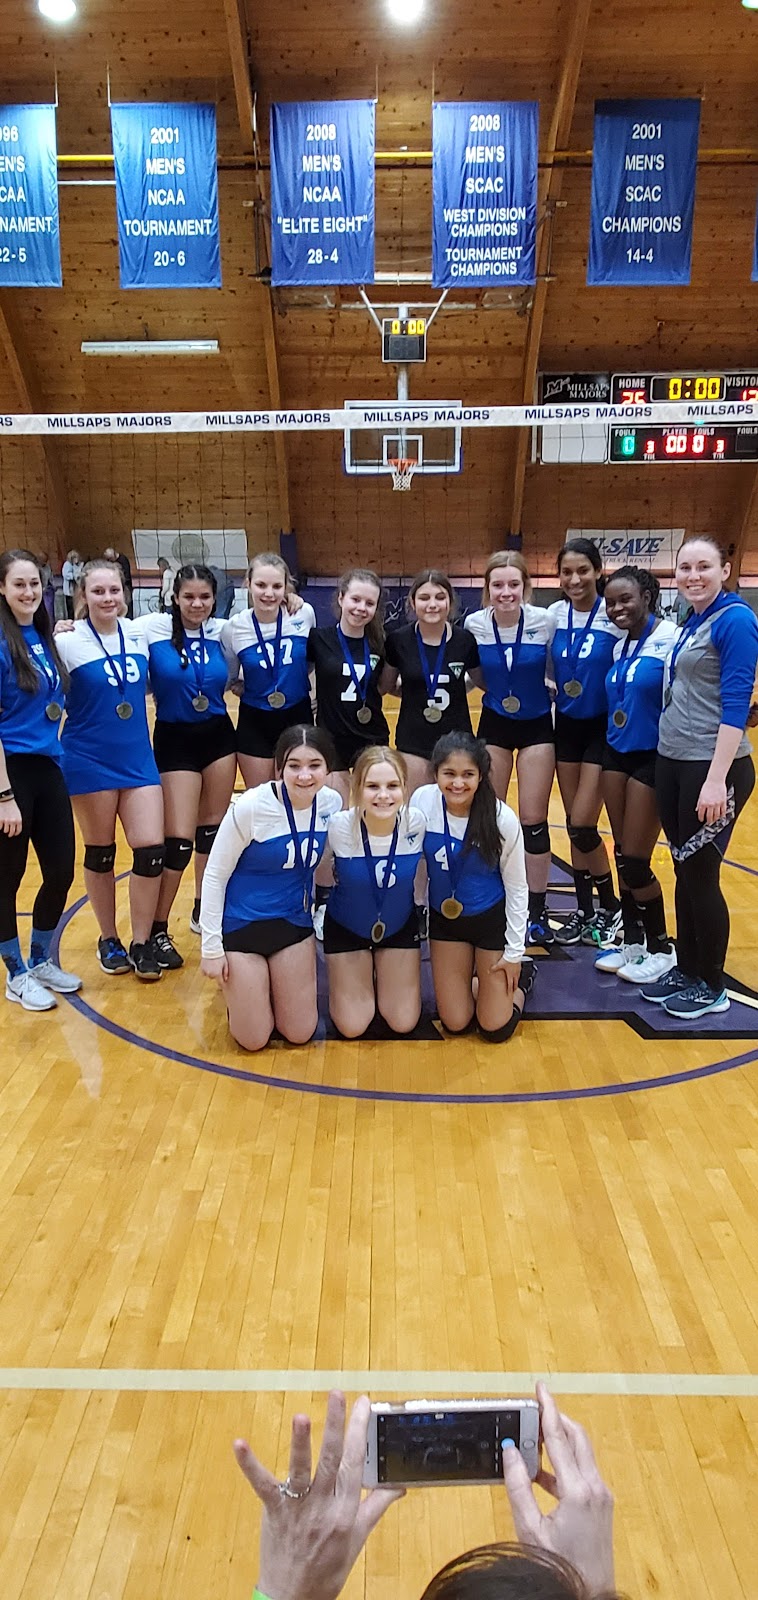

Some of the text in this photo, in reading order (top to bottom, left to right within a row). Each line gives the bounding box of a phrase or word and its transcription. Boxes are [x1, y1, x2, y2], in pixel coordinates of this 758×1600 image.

[470, 114, 501, 132] 2008
[632, 123, 662, 140] 2001
[0, 125, 19, 142] 96
[150, 127, 180, 144] 2001
[306, 124, 337, 141] 2008
[302, 154, 342, 172] MEN'S
[465, 146, 505, 164] MEN'S
[625, 154, 665, 171] MEN'S
[146, 157, 186, 175] MEN'S
[465, 177, 504, 194] SCAC
[625, 185, 662, 202] SCAC
[147, 189, 186, 206] NCAA
[303, 186, 342, 203] NCAA
[443, 206, 527, 223] WEST DIVISION
[123, 218, 213, 237] TOURNAMENT
[277, 215, 369, 234] "ELITE EIGHT"
[451, 221, 519, 238] CHAMPIONS
[602, 216, 682, 234] CHAMPIONS
[445, 246, 523, 262] TOURNAMENT
[626, 247, 654, 264] 14-4
[450, 261, 518, 277] CHAMPIONS
[391, 319, 425, 335] 0:00
[567, 383, 610, 391] MILLSAPS
[619, 378, 646, 389] HOME
[668, 377, 720, 400] 0:00
[569, 390, 607, 399] MAJORS
[205, 412, 332, 425] MILLSAPS MAJORS
[363, 410, 490, 423] MILLSAPS MAJORS
[524, 406, 653, 419] MILLSAPS MAJORS
[687, 404, 754, 416] MILLSAPS
[47, 415, 172, 428] MILLSAPS MAJORS
[614, 429, 636, 437] FOULS
[662, 428, 715, 436] PLAYER FOULS
[623, 436, 635, 455] 0
[647, 440, 655, 453] 3
[716, 439, 725, 452] 3
[504, 646, 513, 673] 1
[103, 656, 140, 687] 99
[611, 658, 642, 683] 4
[341, 662, 367, 702] 7
[427, 674, 450, 711] 5
[282, 837, 319, 870] 16
[375, 859, 397, 889] 6
